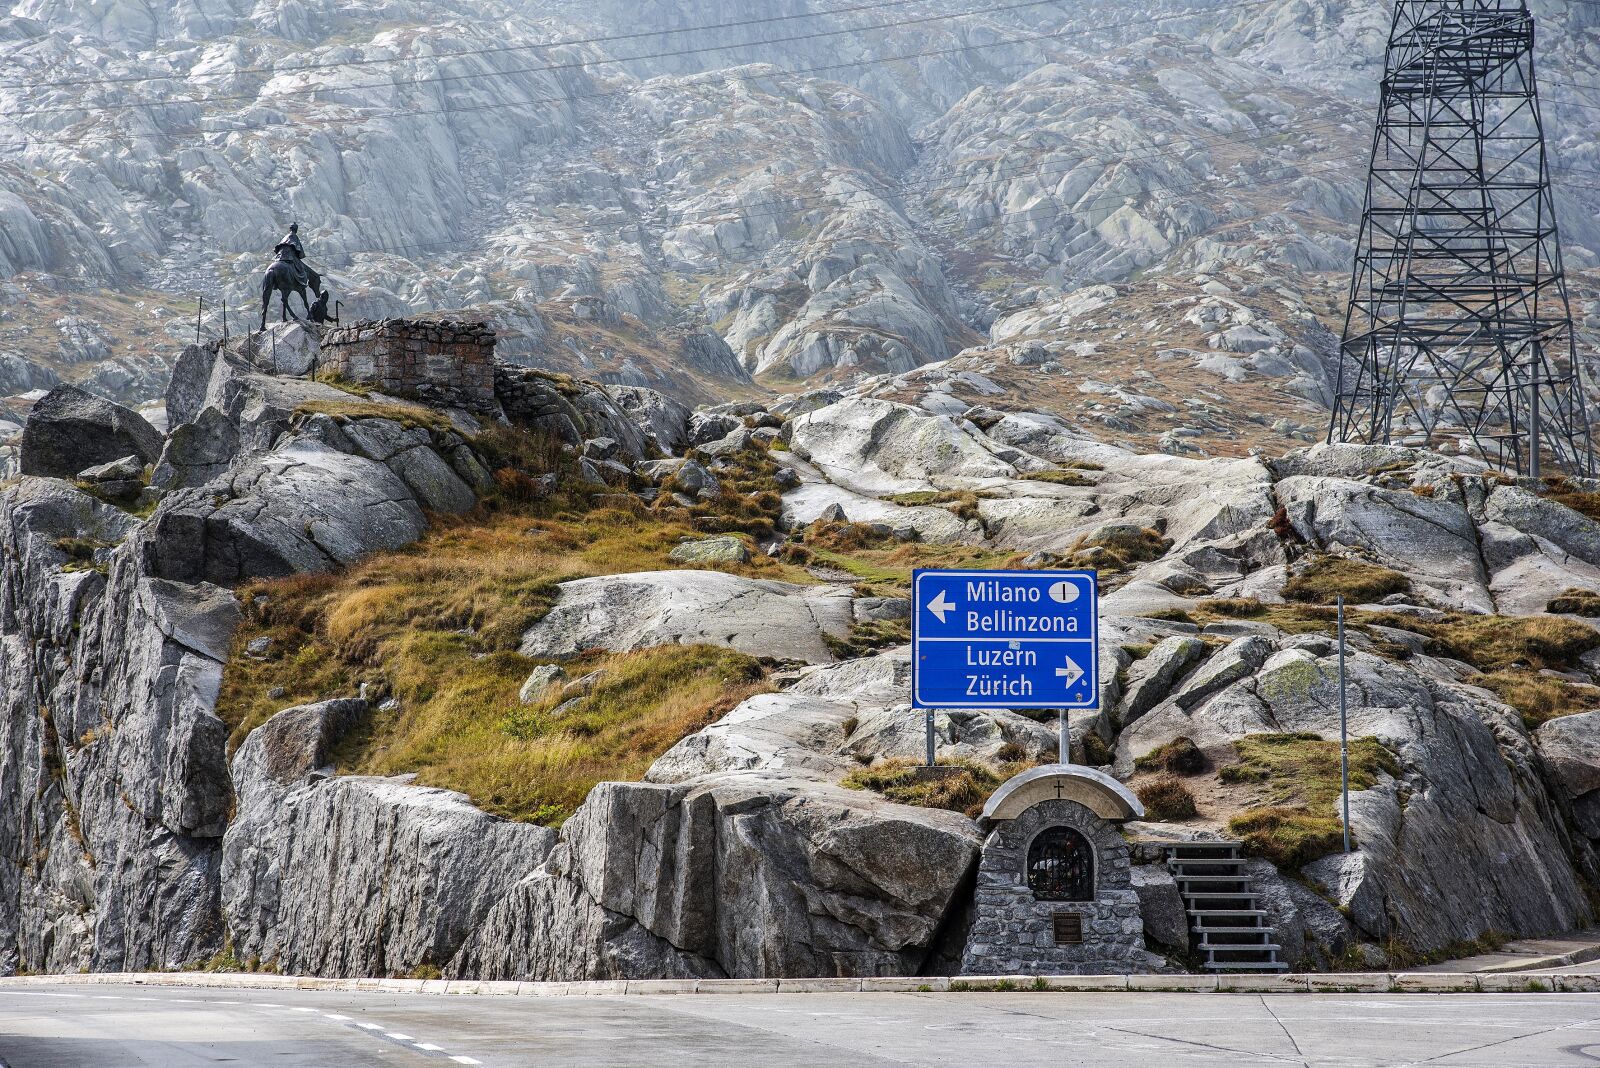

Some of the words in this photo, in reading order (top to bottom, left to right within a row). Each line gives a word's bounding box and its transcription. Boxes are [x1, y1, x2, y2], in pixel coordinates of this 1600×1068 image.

[967, 581, 1041, 602] Milano
[967, 610, 1078, 632] Bellinzona
[967, 645, 1037, 666] Luzern
[966, 674, 1033, 696] Zürich
